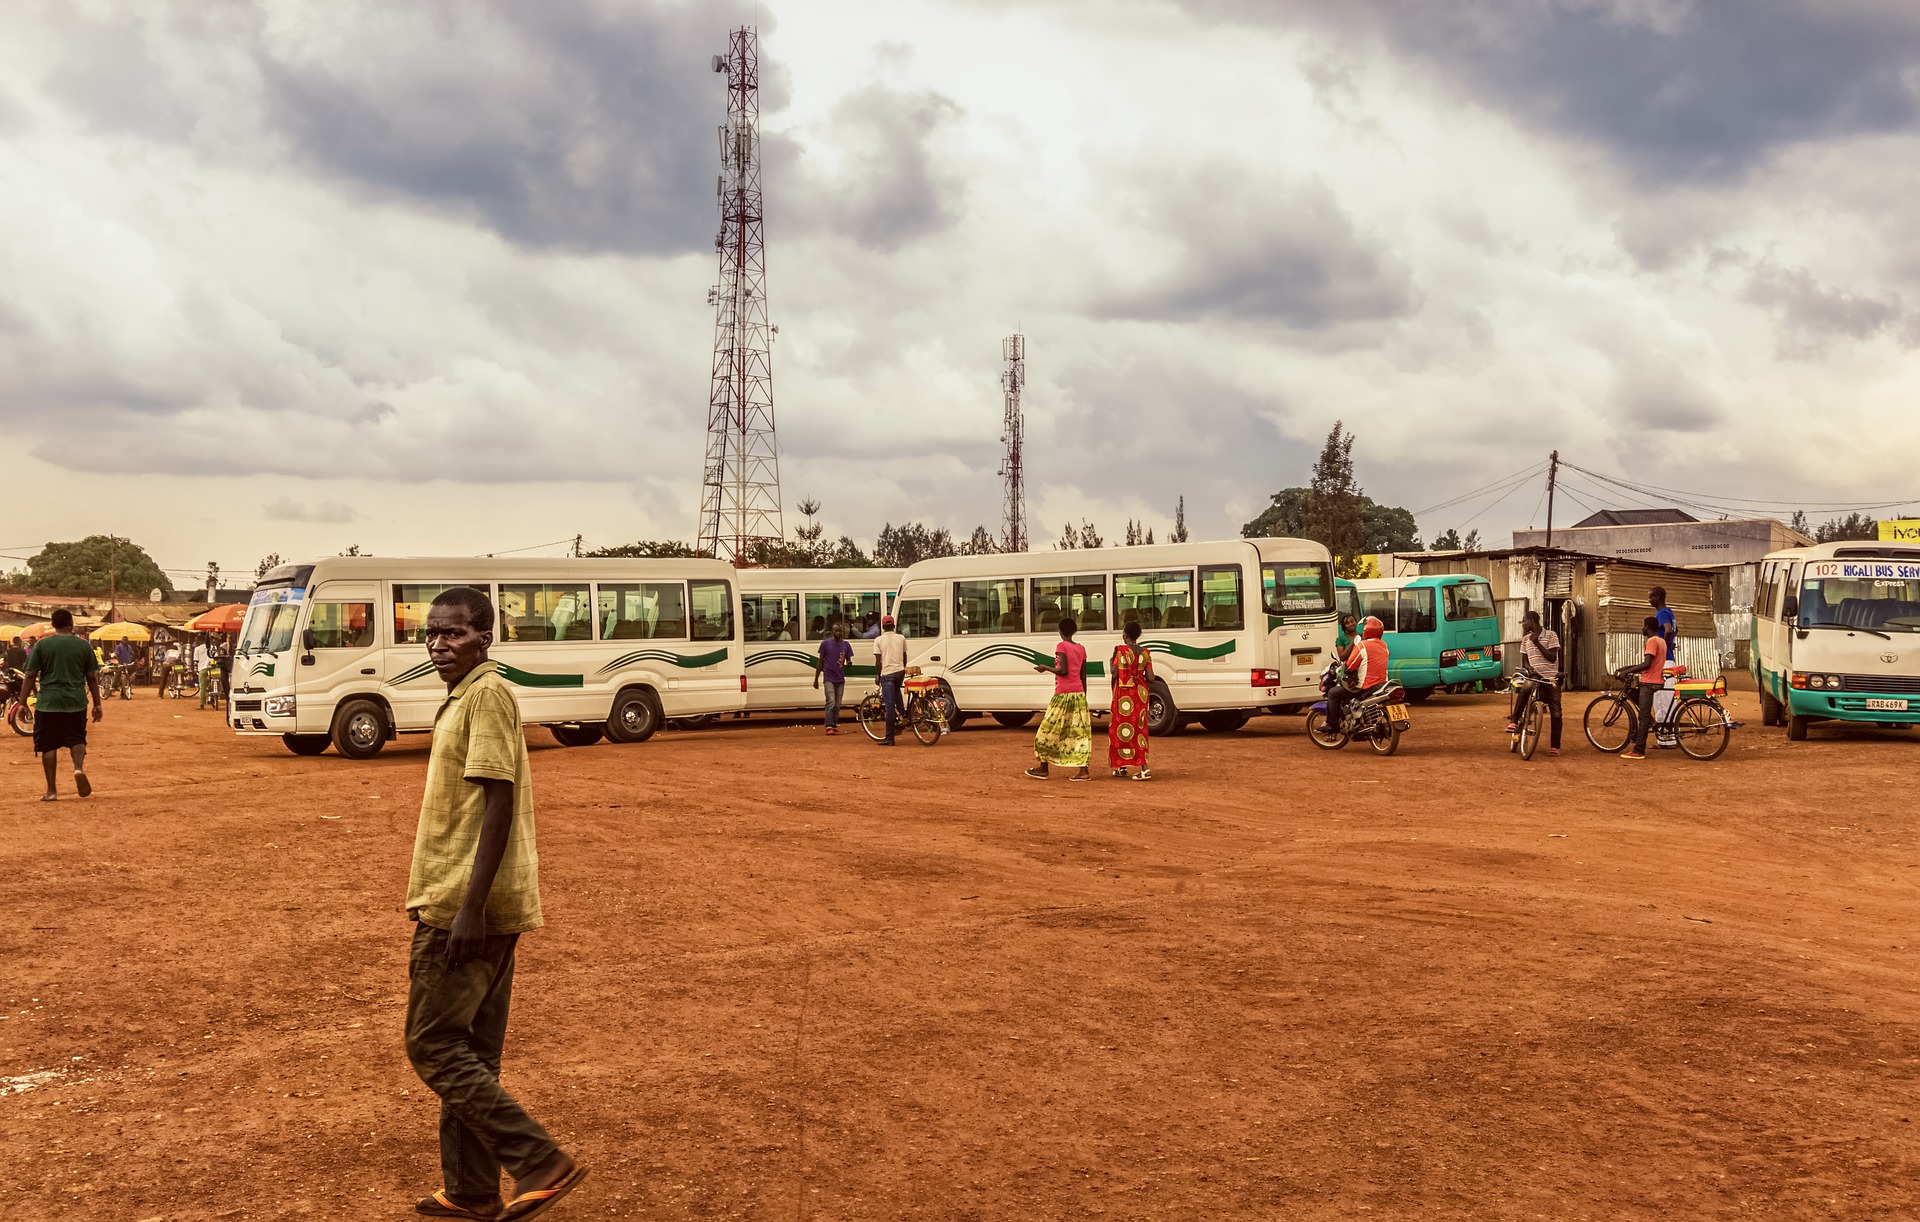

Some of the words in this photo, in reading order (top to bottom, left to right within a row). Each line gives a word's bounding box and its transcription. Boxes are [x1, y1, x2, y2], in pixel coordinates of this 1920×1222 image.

[1816, 564, 1838, 576] 102
[1843, 564, 1873, 577] KIGALI
[1875, 565, 1894, 577] BUS
